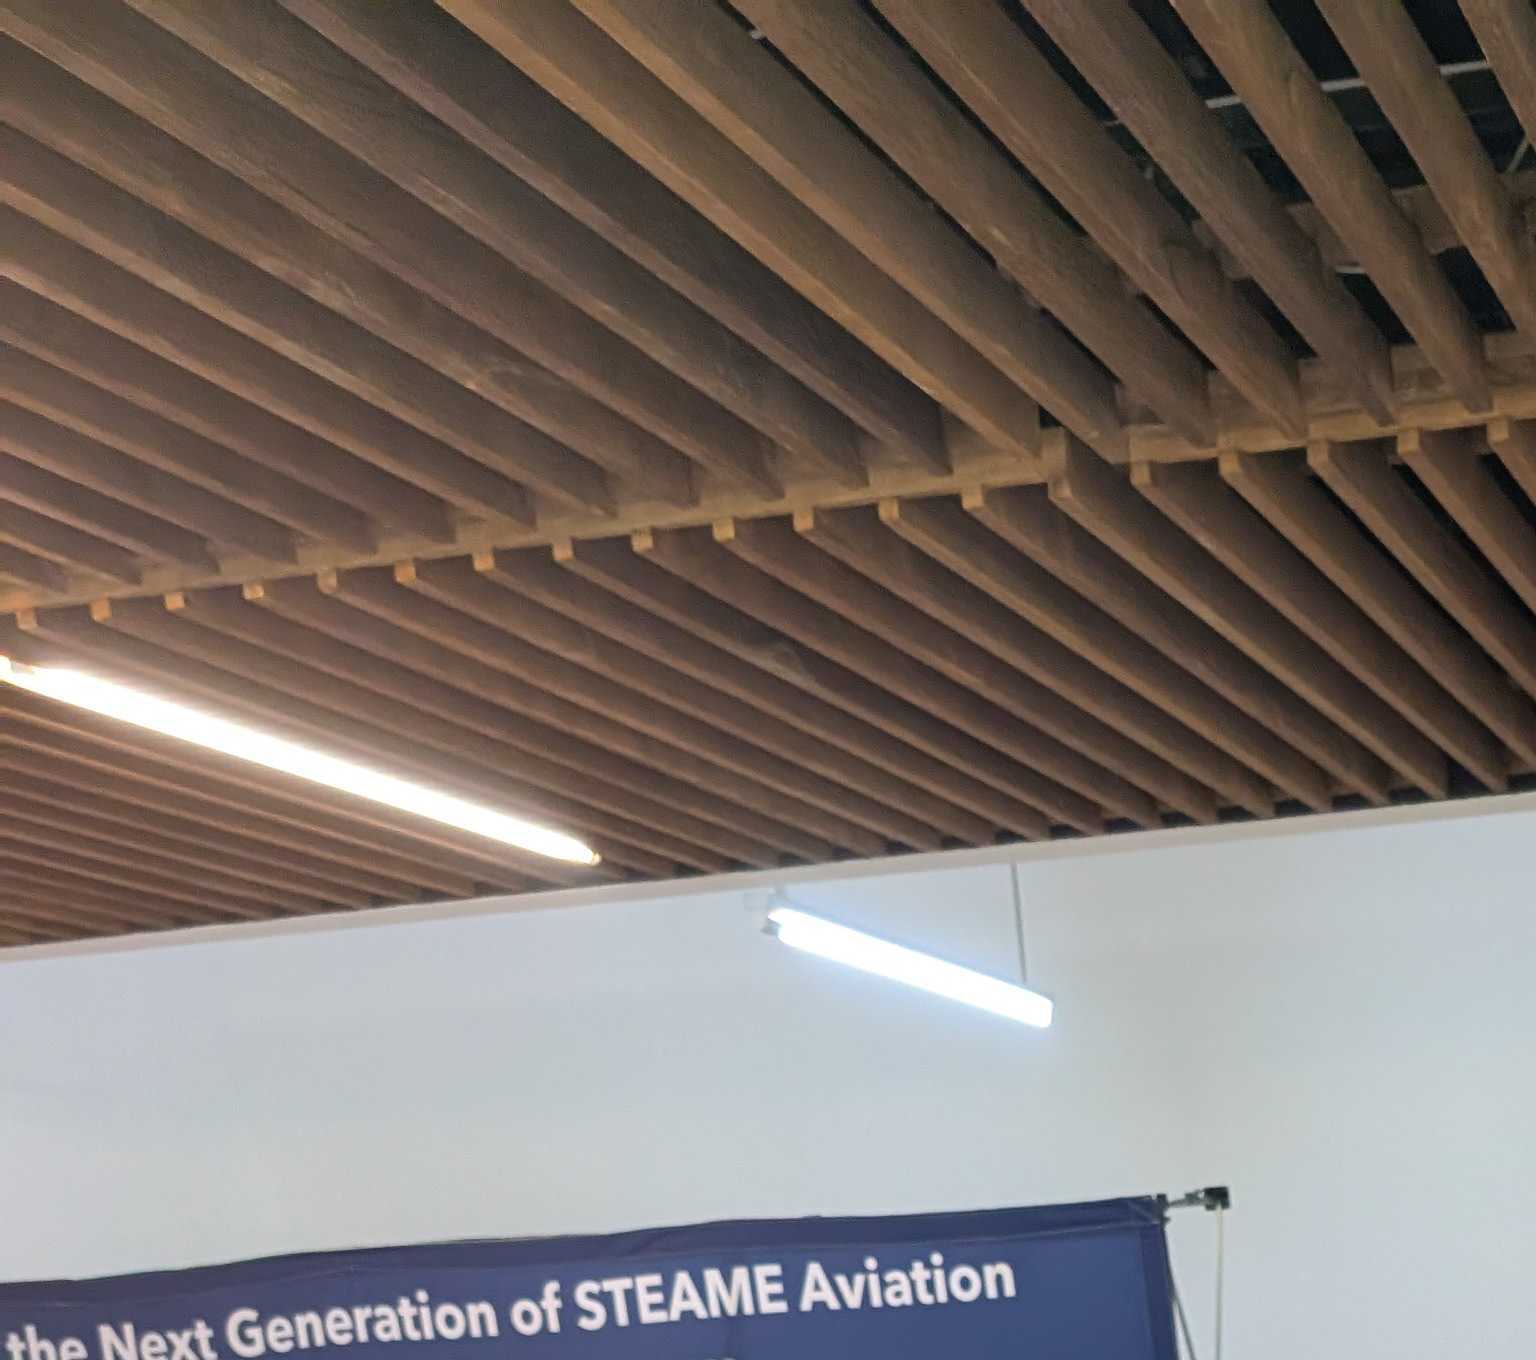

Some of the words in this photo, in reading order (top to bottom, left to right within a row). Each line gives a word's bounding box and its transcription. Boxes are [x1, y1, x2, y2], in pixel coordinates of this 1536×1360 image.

[225, 1288, 500, 1358] Generation
[510, 1280, 563, 1336] of
[574, 1263, 789, 1332] STEAME
[800, 1252, 1017, 1312] Aviation
